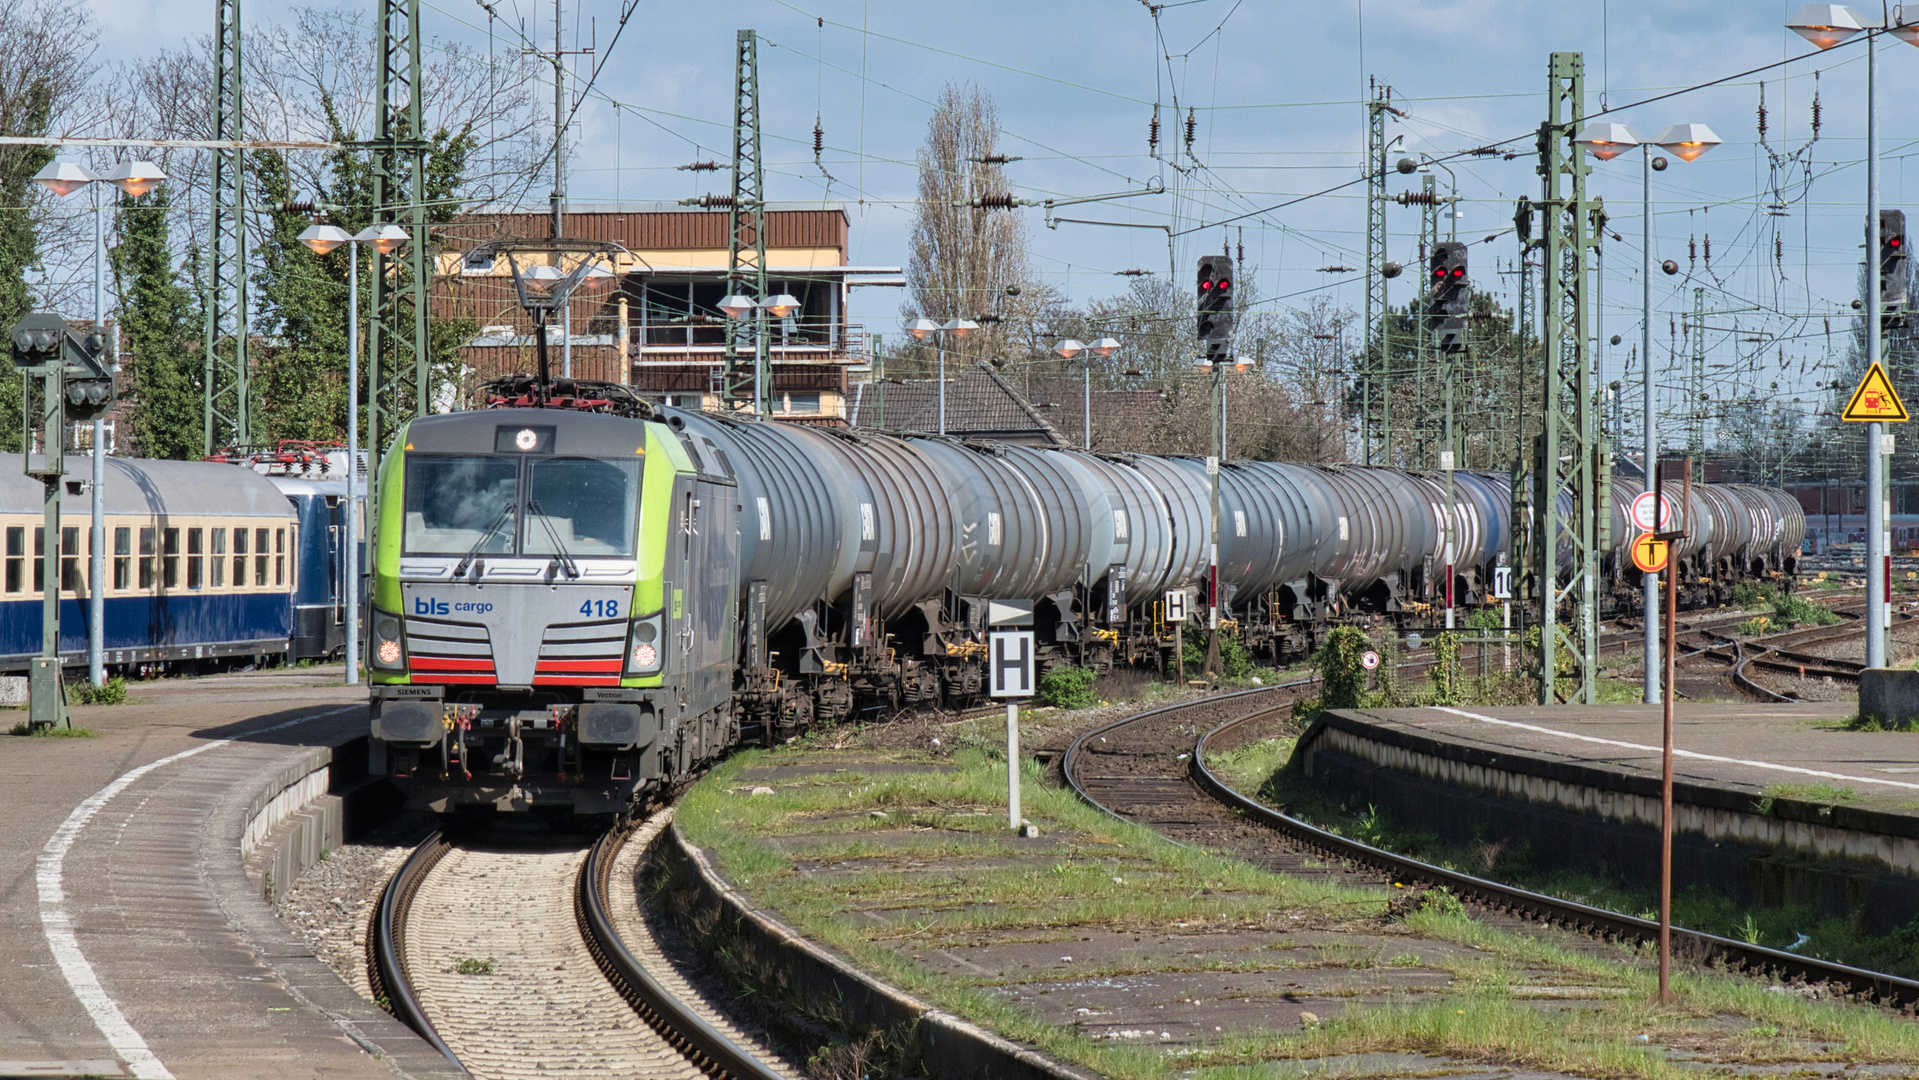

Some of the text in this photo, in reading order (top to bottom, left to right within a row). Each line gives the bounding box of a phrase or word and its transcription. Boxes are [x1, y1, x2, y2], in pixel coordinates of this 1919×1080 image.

[415, 597, 493, 615] bls cargo
[579, 599, 618, 617] 418
[1168, 594, 1184, 618] H
[995, 637, 1030, 690] H
